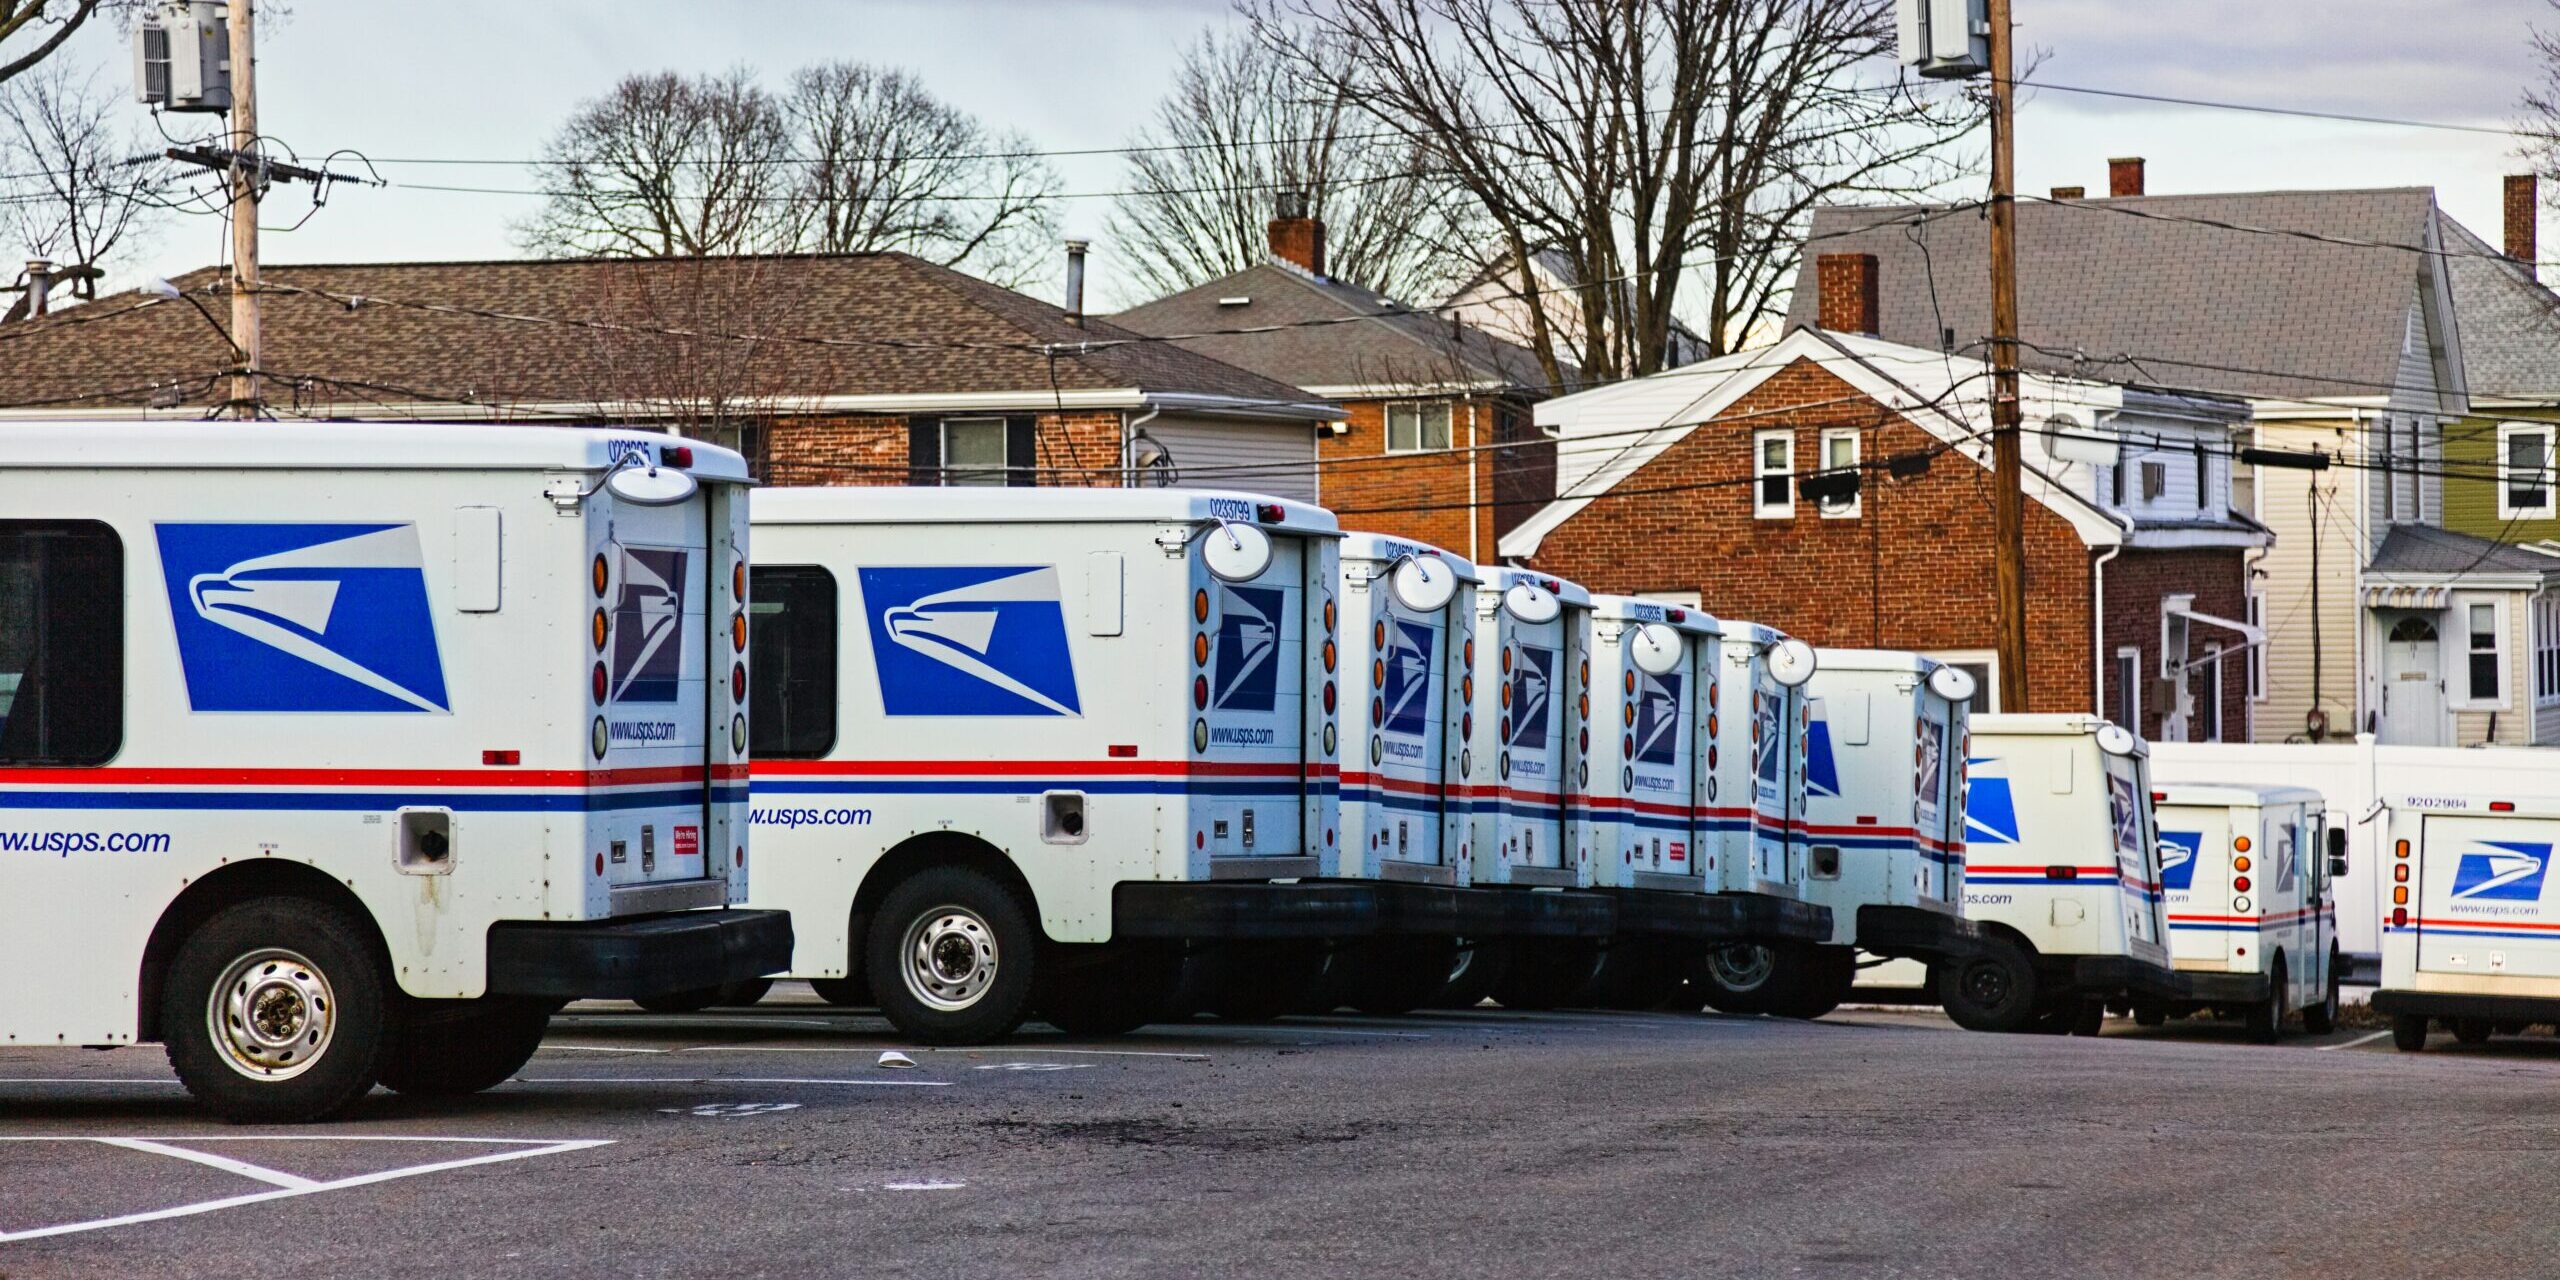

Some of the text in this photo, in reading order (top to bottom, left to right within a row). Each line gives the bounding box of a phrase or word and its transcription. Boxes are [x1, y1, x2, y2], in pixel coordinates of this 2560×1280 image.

[1210, 498, 1250, 521] 0233799
[609, 721, 676, 747] www.usps.com
[1211, 727, 1274, 748] www.usps.com
[2407, 795, 2468, 809] 9202984
[2450, 904, 2539, 916] www.usps.com
